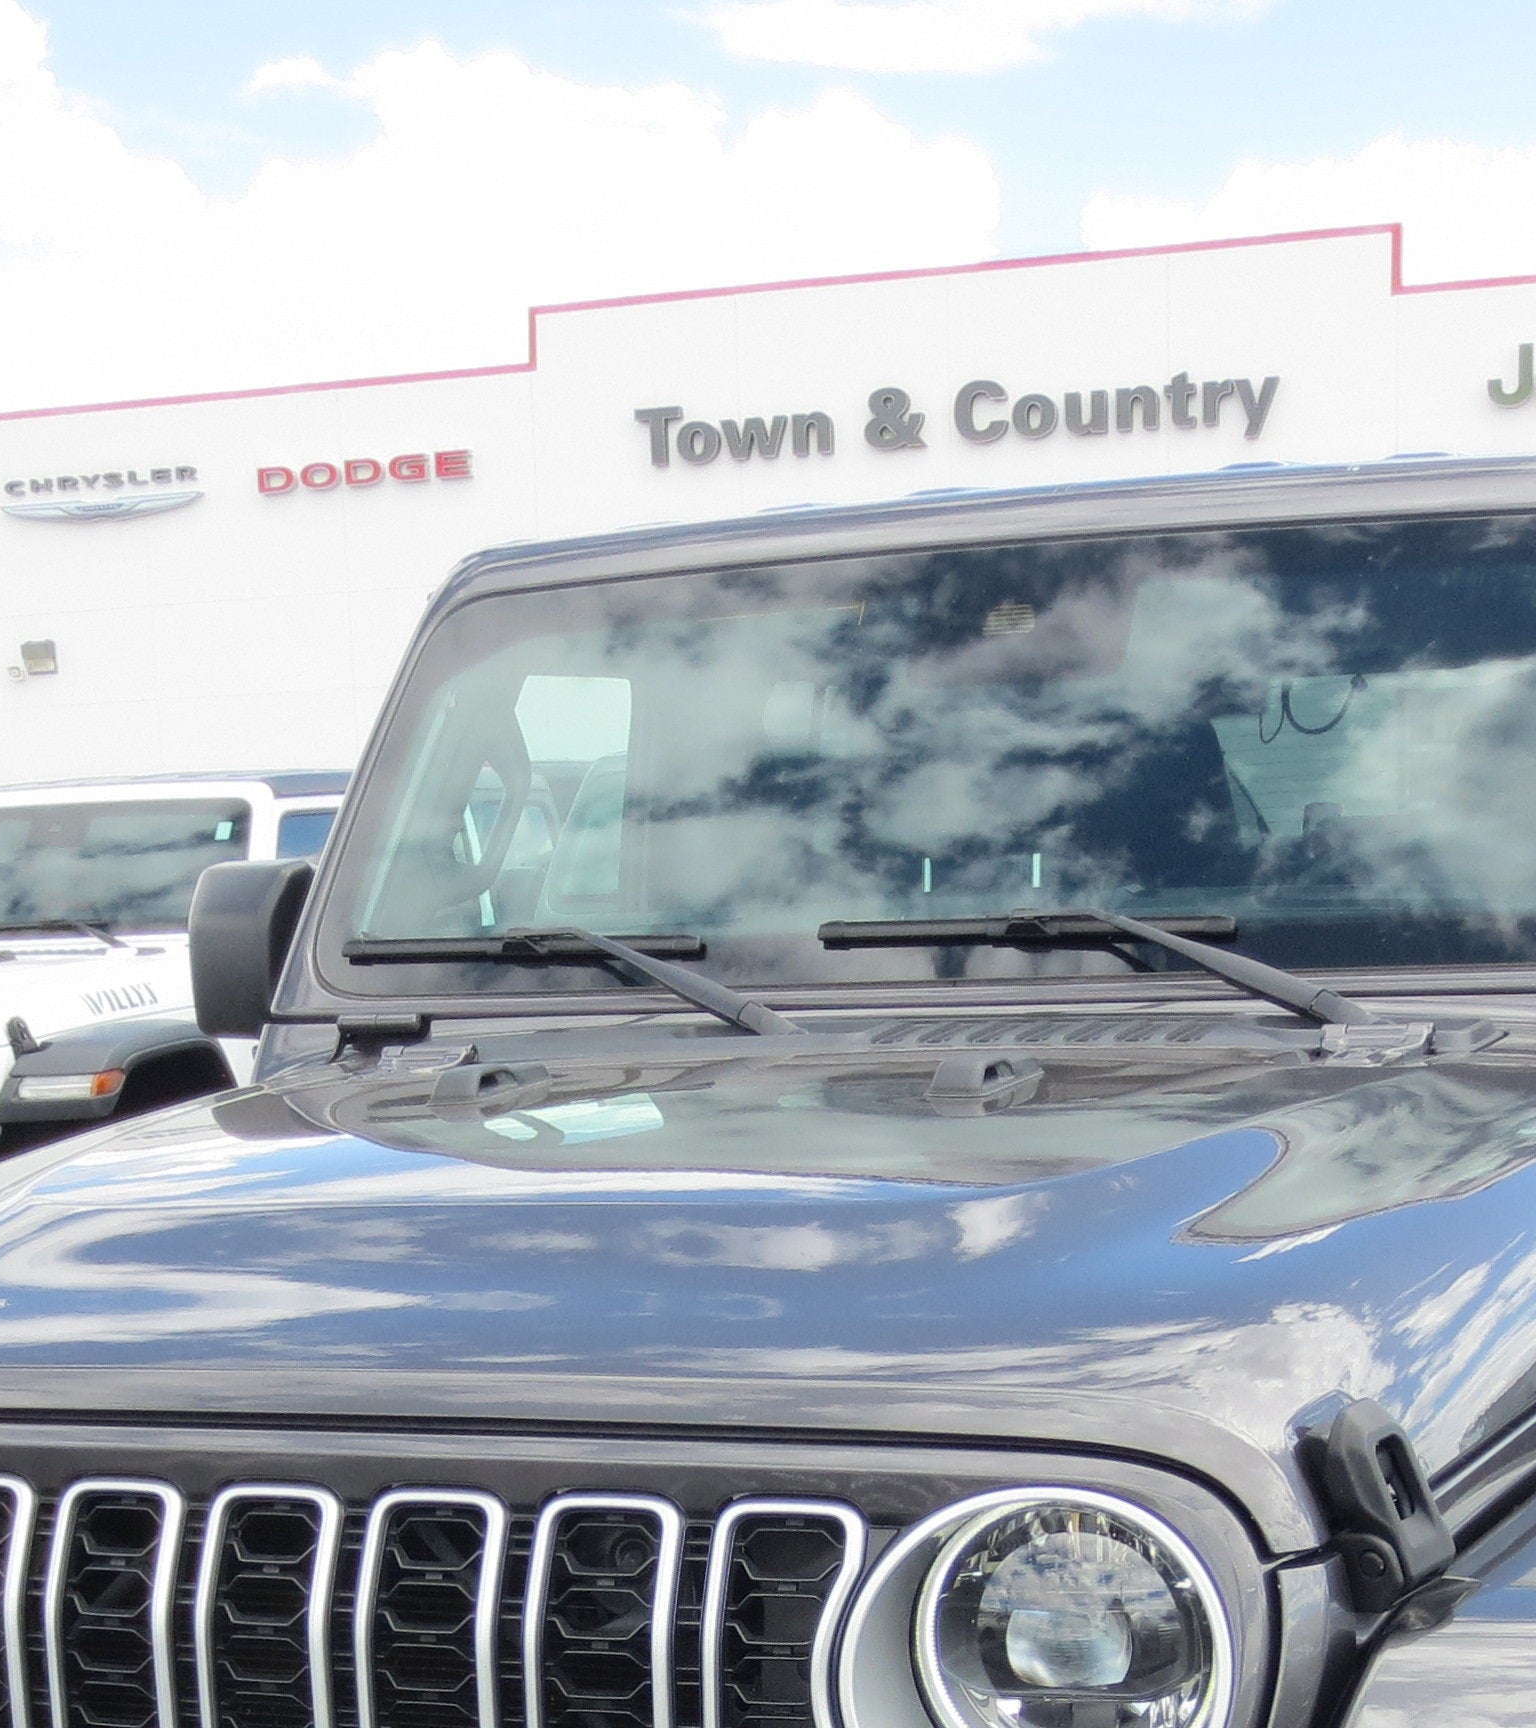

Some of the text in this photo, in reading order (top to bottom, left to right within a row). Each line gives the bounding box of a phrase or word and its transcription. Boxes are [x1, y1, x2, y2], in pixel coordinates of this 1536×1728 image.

[633, 371, 1281, 468] Town & Country
[3, 465, 199, 497] CHRYSLER
[256, 449, 474, 495] DODGE
